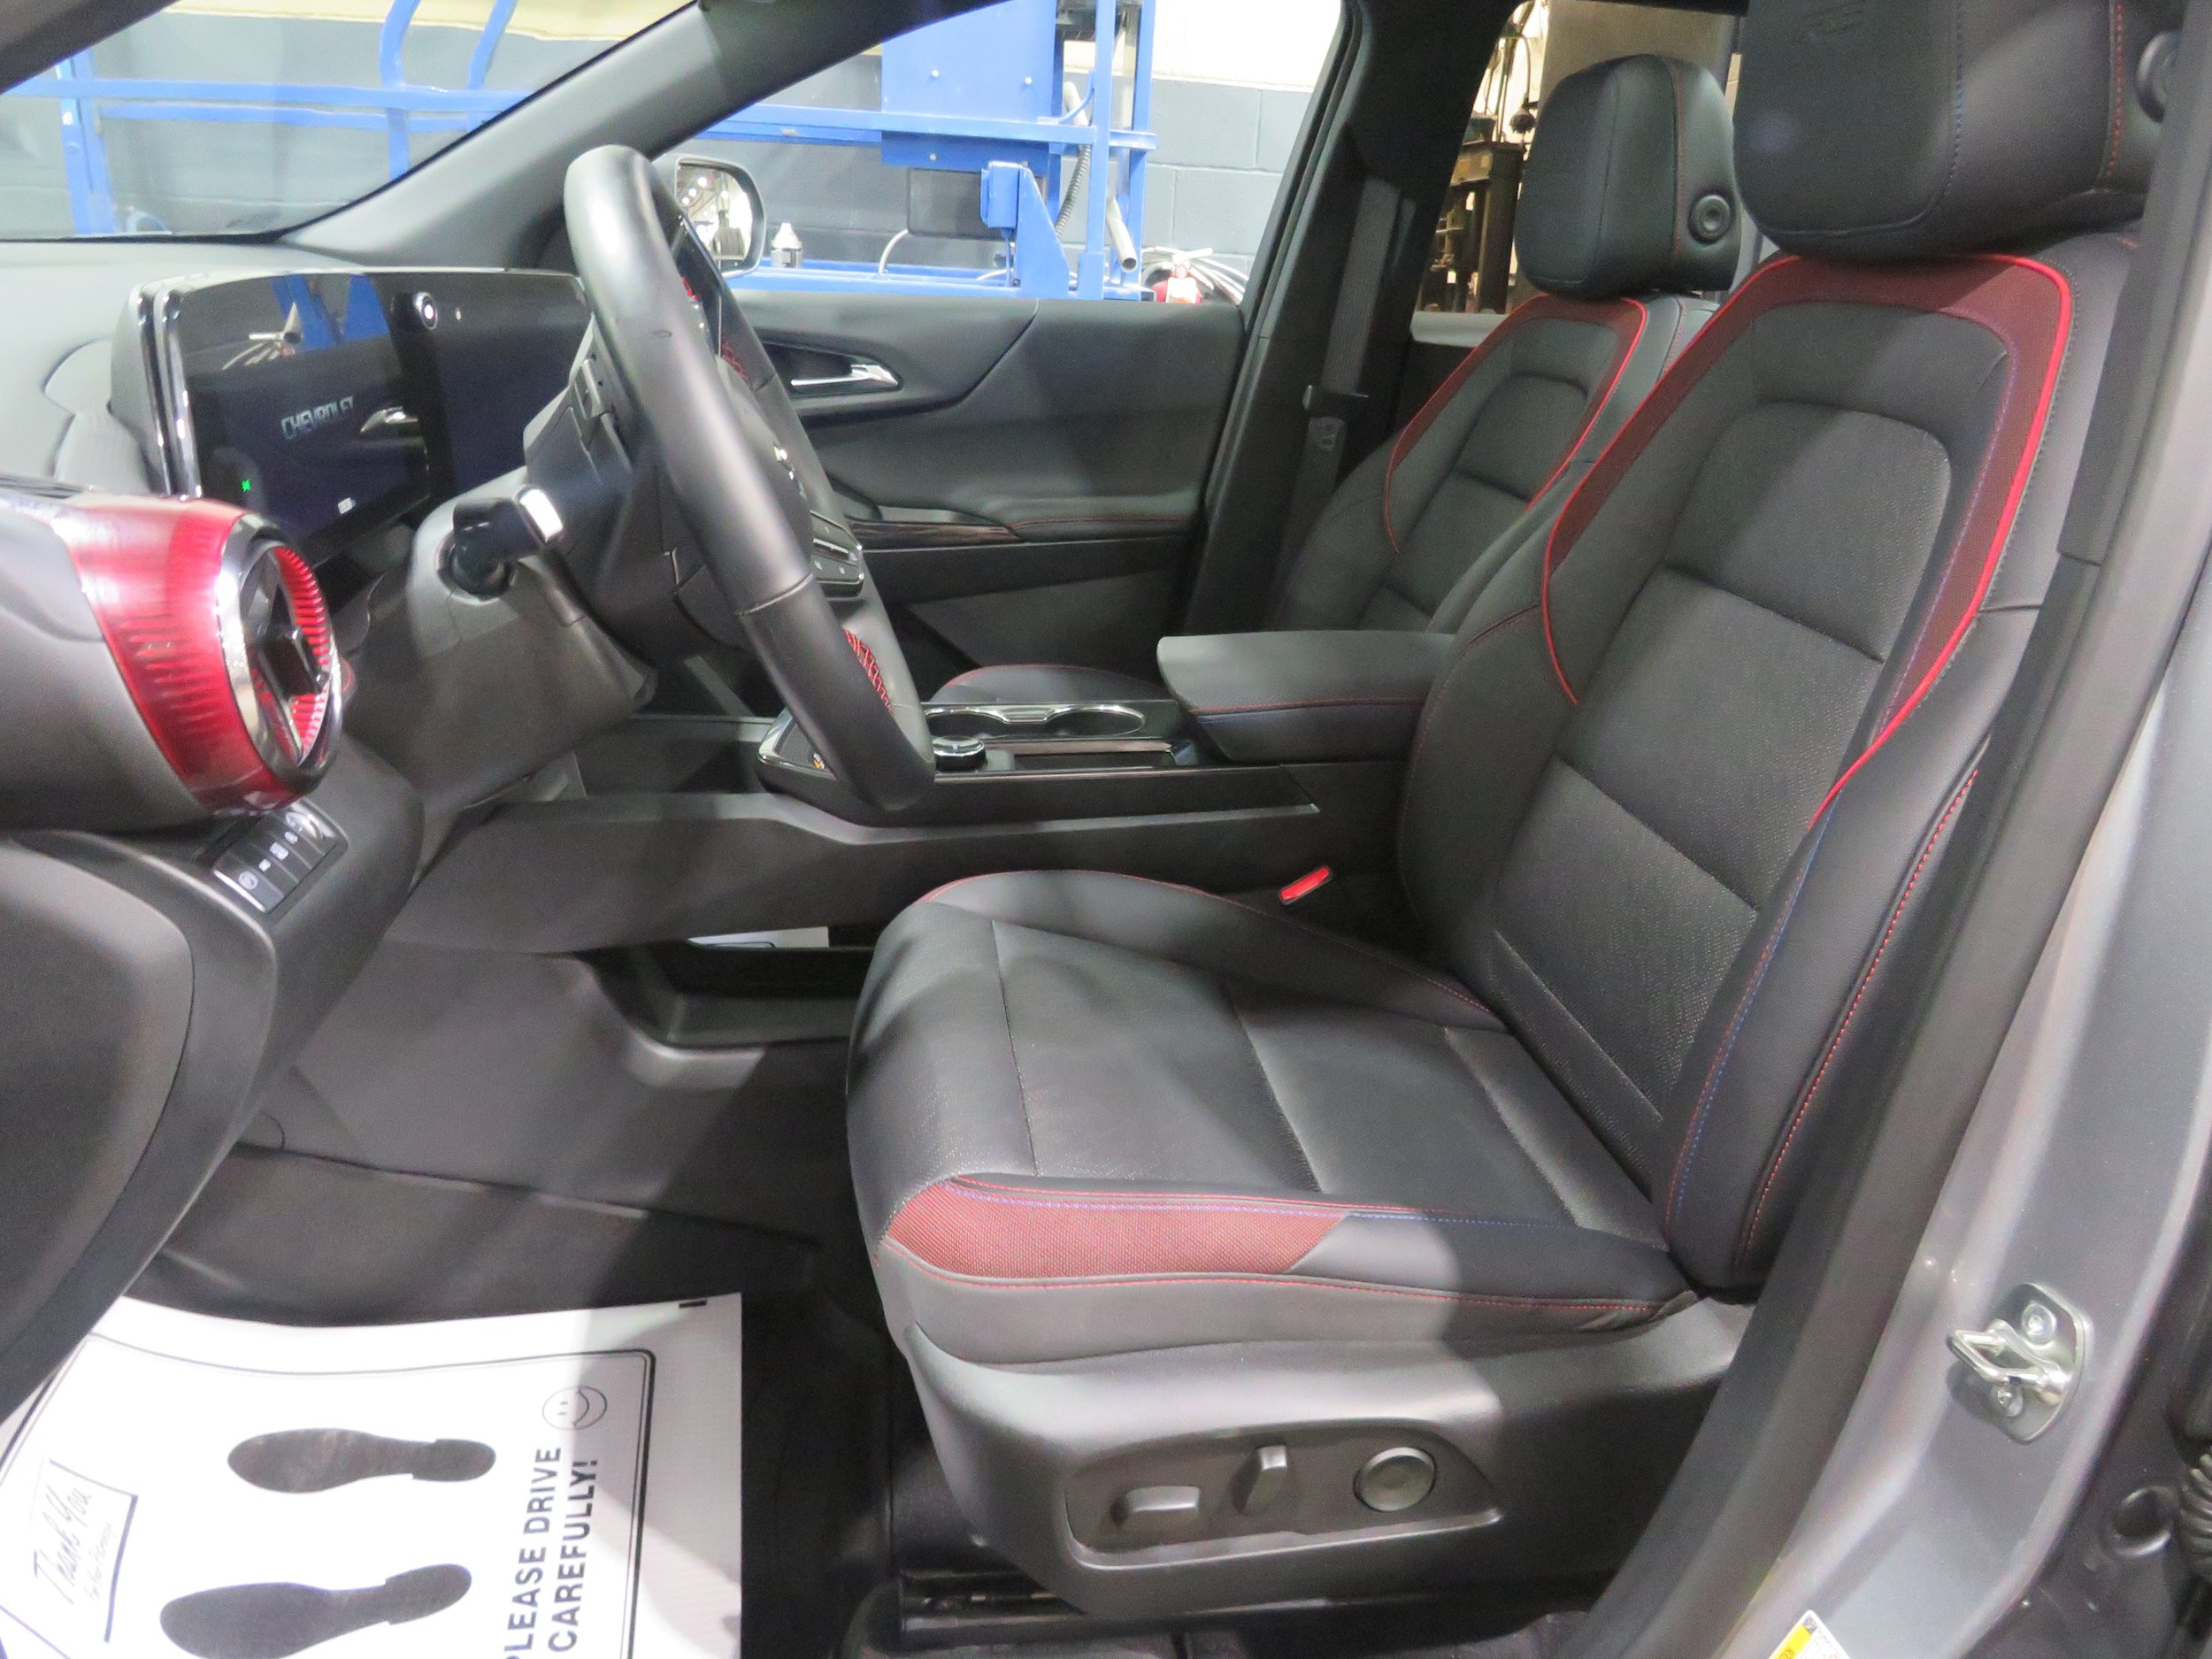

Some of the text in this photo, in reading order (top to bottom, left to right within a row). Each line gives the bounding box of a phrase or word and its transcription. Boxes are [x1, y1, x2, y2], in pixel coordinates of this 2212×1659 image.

[35, 1484, 92, 1604] Thank You
[504, 1448, 562, 1659] LEASE DRIVE
[548, 1460, 598, 1652] CAREFULLY!
